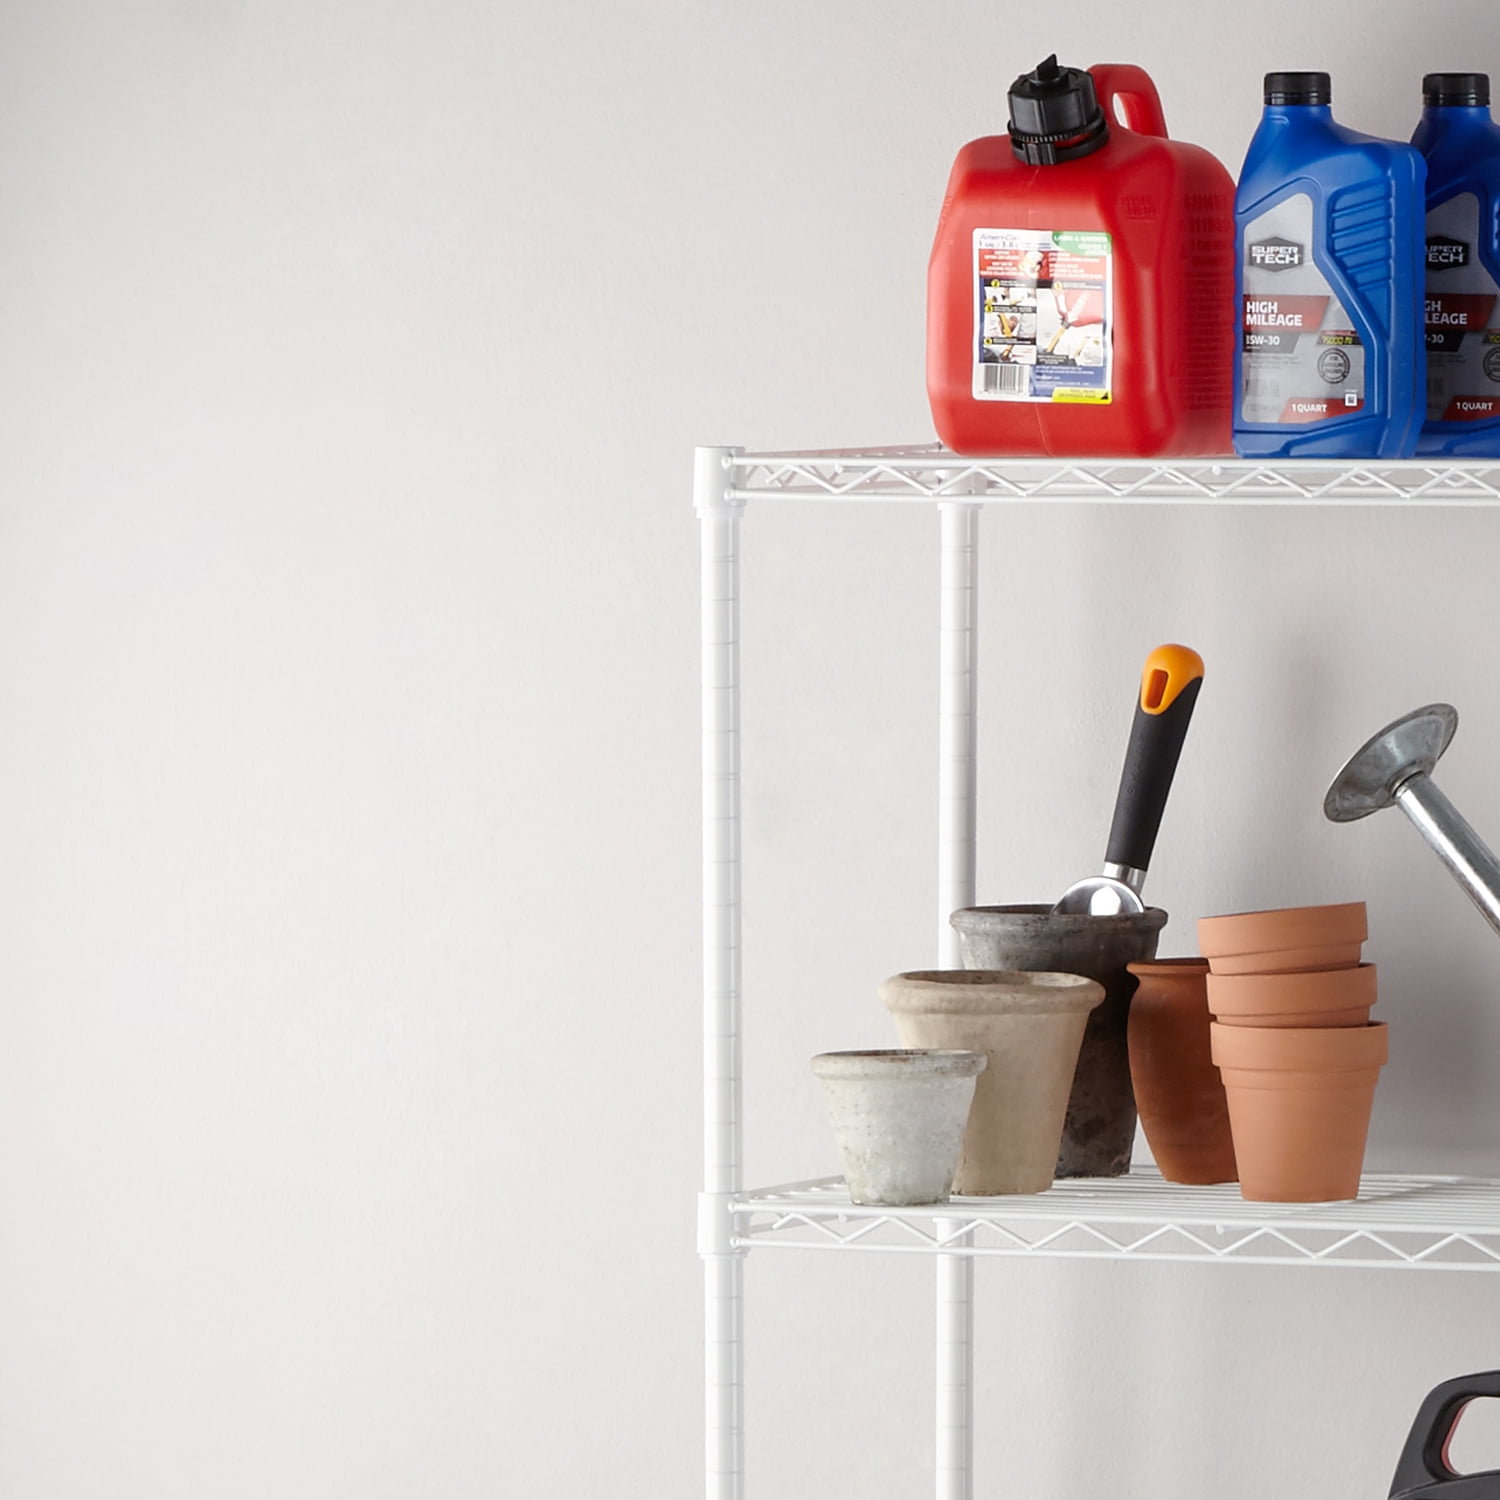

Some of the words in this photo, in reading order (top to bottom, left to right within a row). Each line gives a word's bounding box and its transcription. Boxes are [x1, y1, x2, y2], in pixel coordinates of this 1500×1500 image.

[1251, 245, 1298, 255] SUPER
[1424, 245, 1463, 253] UPER
[1251, 253, 1299, 264] TECH
[1427, 252, 1463, 263] ECH
[1246, 301, 1278, 313] HIGH
[1246, 313, 1303, 326] MILEAGE
[1424, 312, 1468, 325] LEAGE
[1291, 403, 1296, 411] 1
[1297, 403, 1327, 413] QUART
[1461, 402, 1493, 411] QUART
